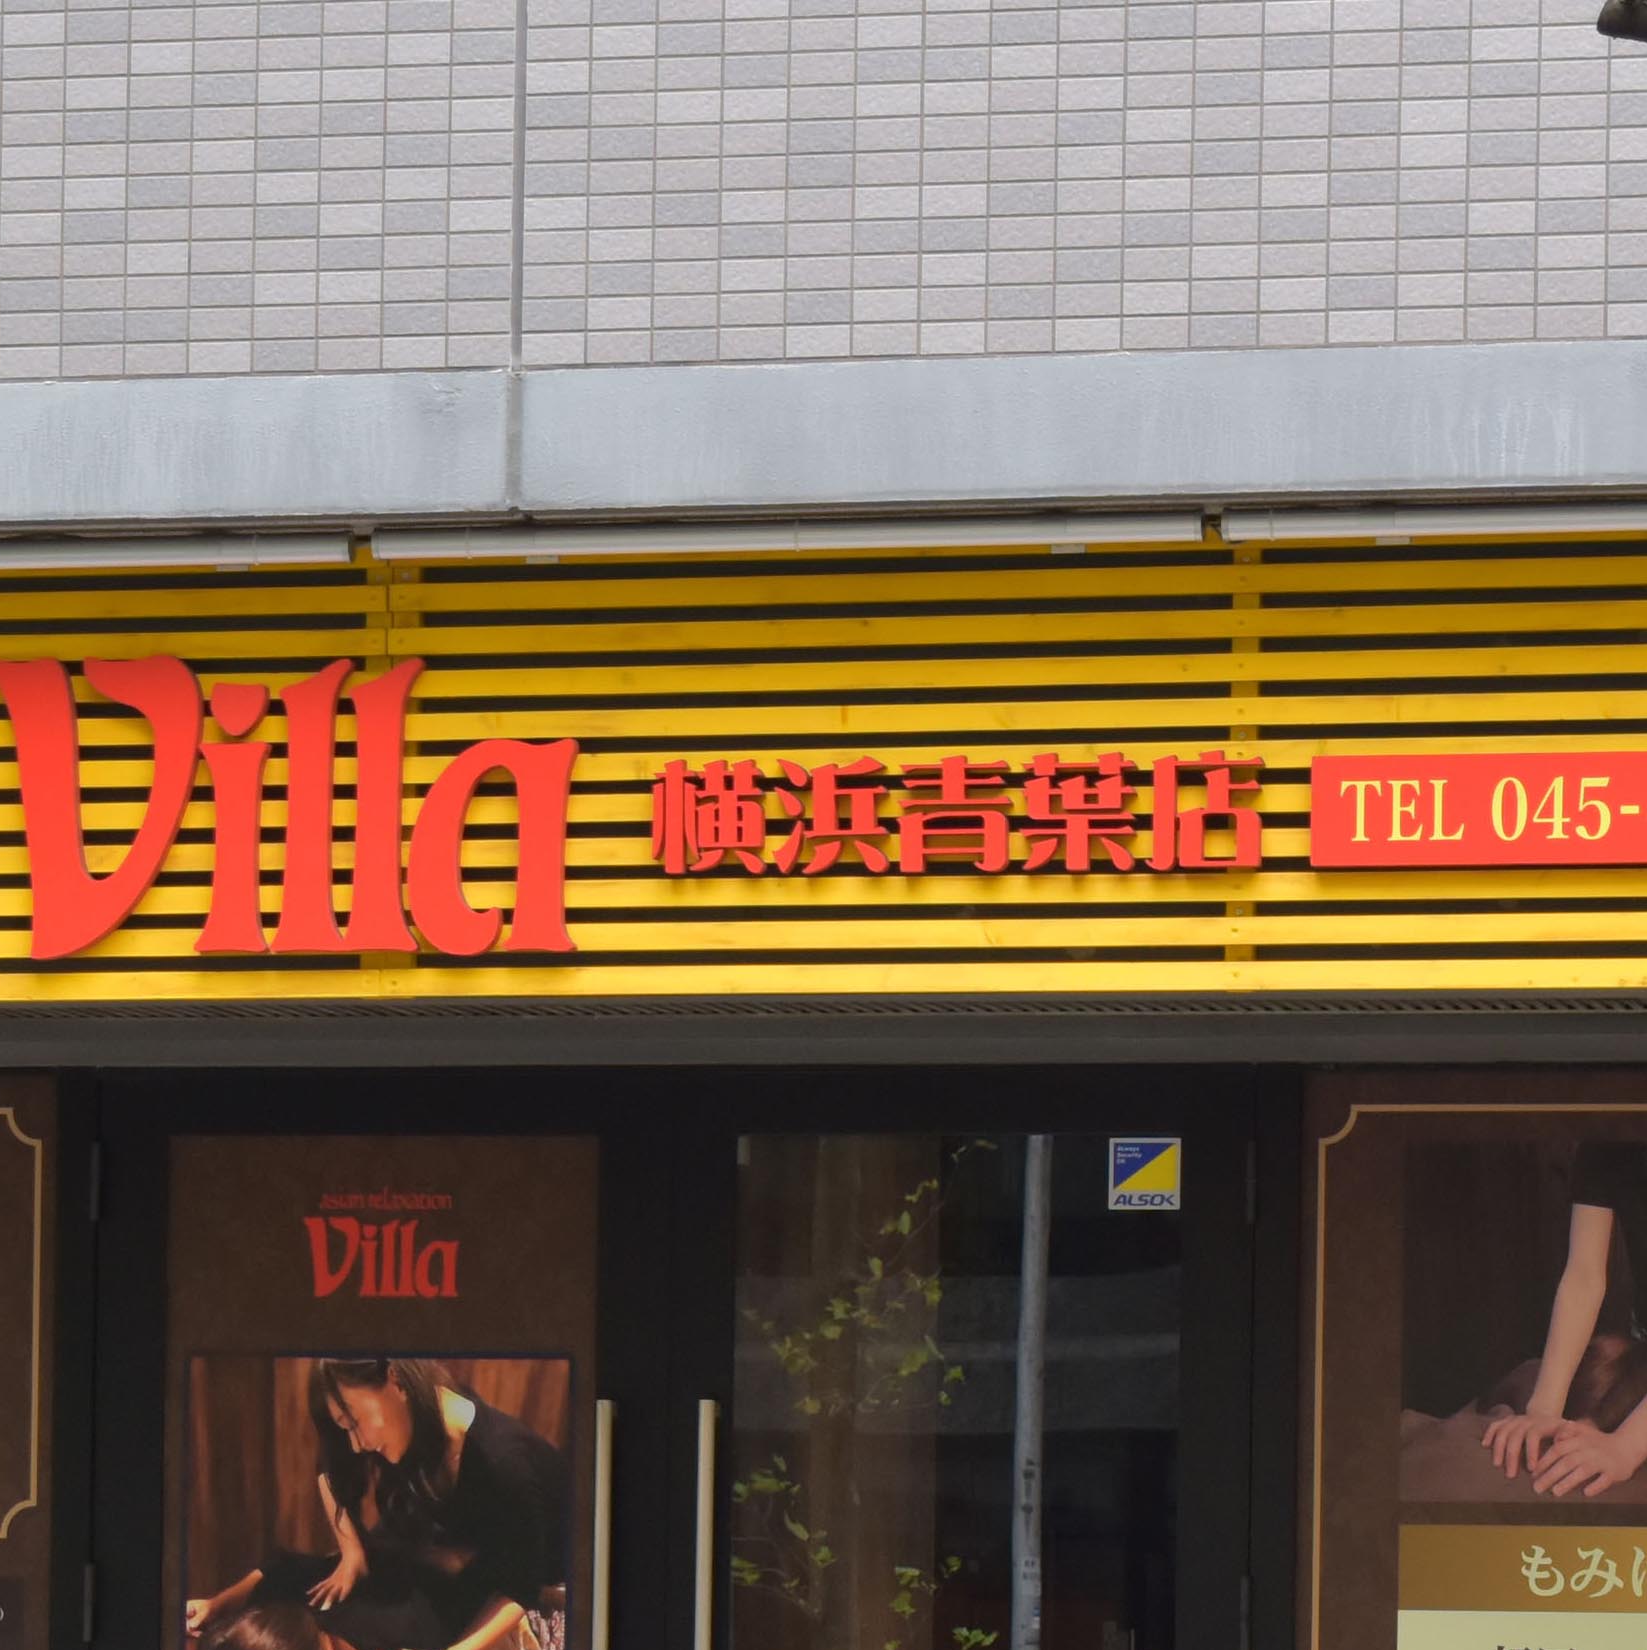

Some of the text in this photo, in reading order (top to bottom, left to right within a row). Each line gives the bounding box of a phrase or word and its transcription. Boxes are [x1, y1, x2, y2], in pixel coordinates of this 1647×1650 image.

[650, 750, 1264, 878] 横浜青葉店
[1338, 780, 1464, 844] TEL
[1113, 1194, 1174, 1206] ALSOK
[304, 1216, 459, 1298] Villa
